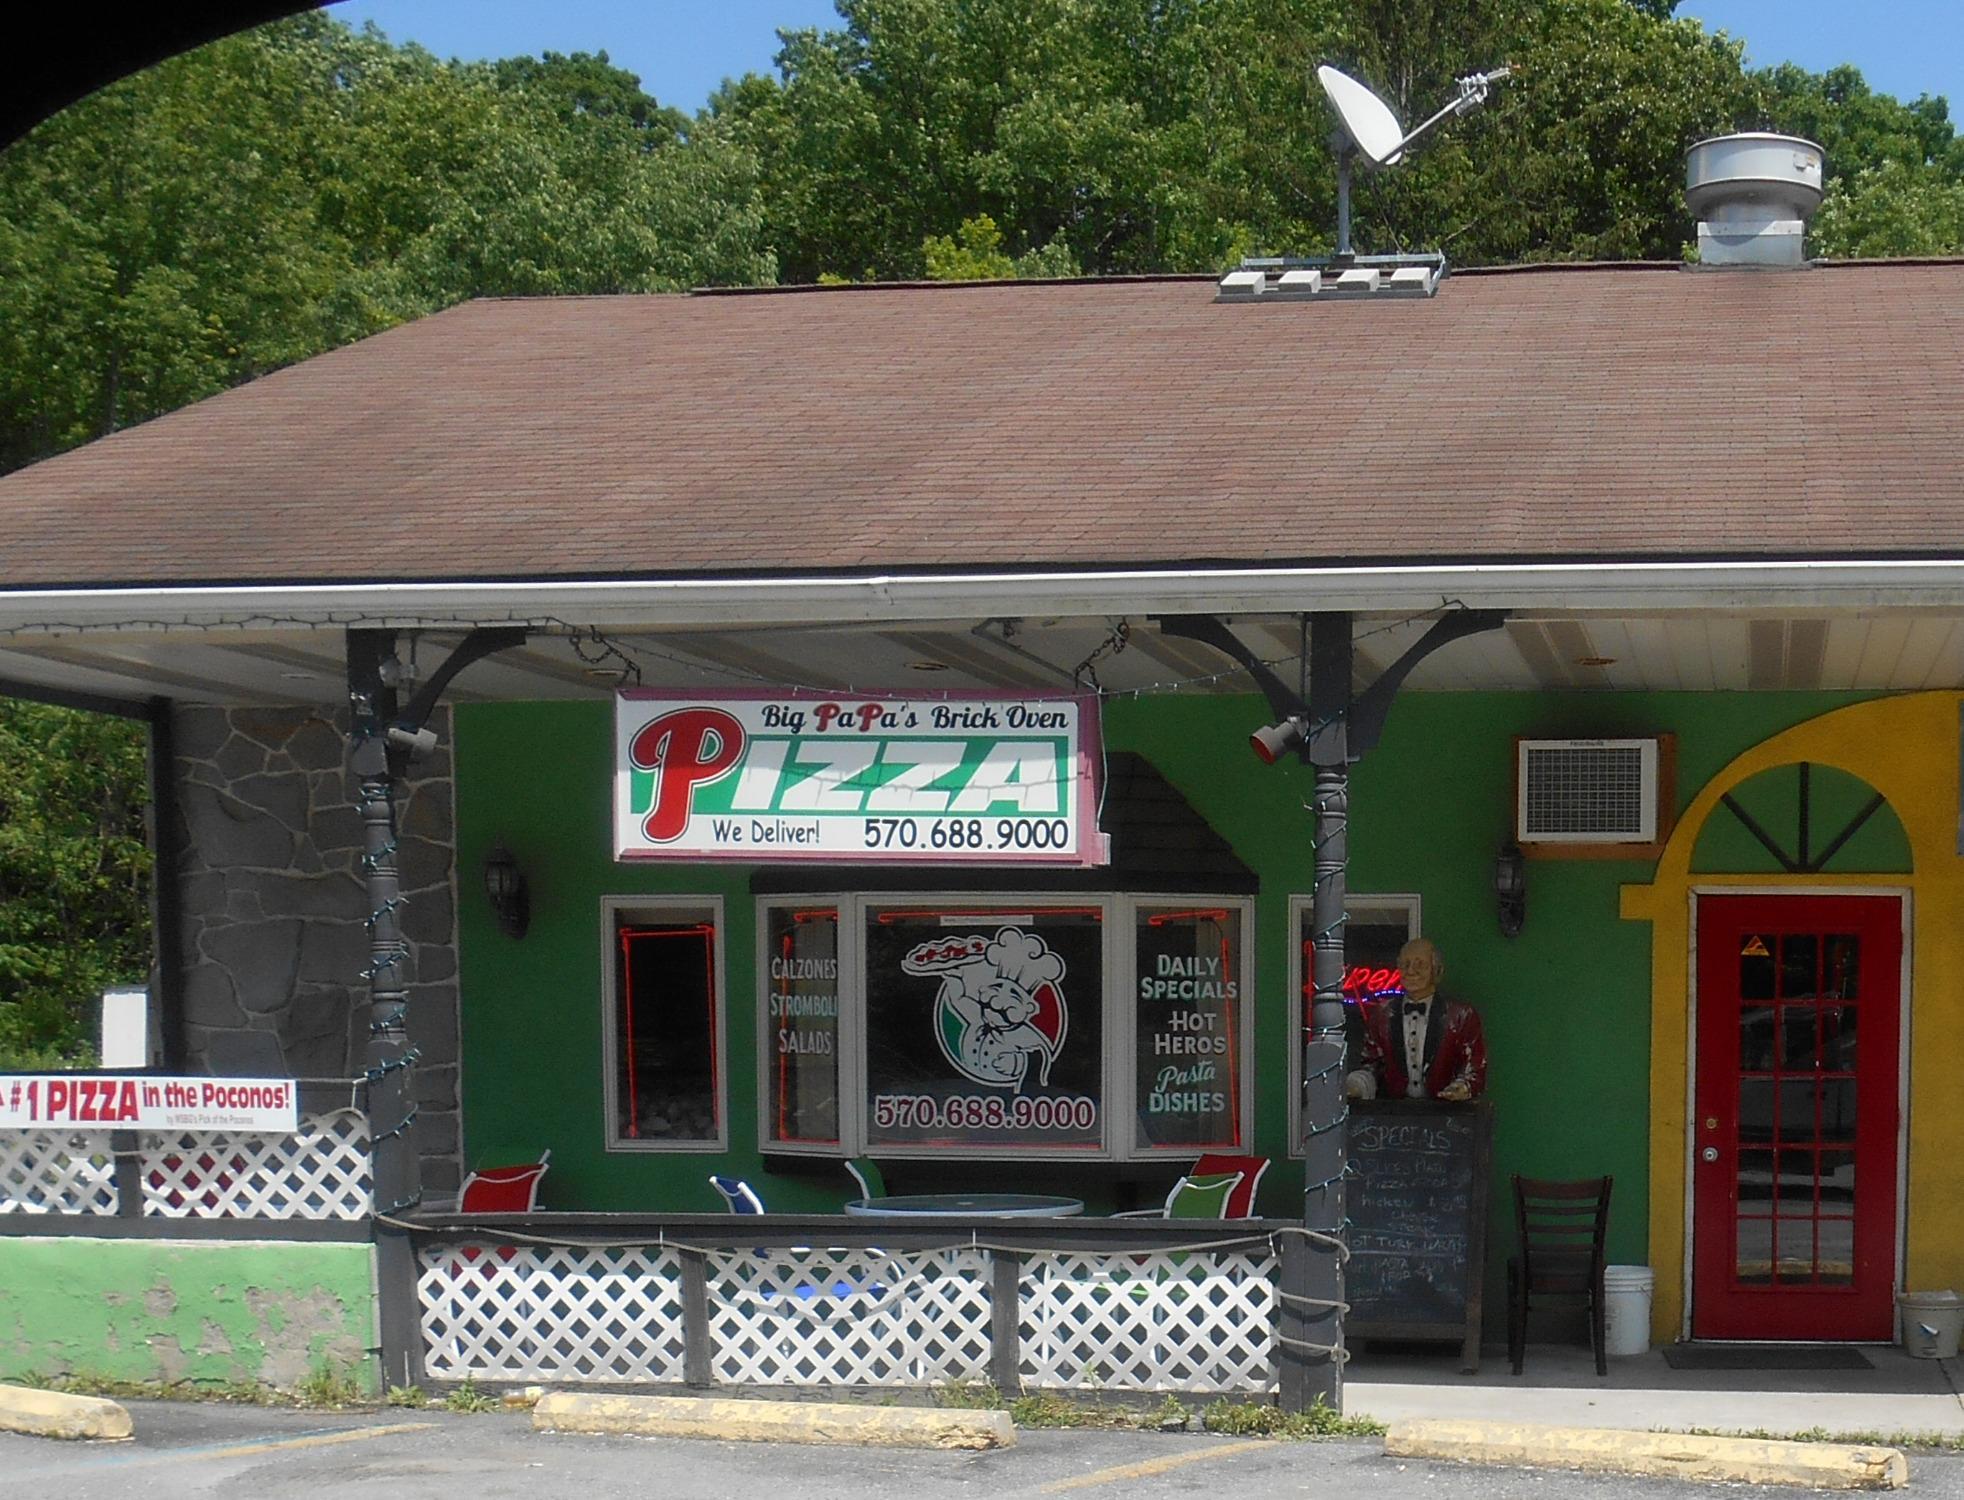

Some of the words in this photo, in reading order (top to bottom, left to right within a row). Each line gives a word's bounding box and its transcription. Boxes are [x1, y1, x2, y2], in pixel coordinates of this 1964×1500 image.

[762, 704, 806, 734] Big
[813, 702, 918, 732] PaPa's
[931, 704, 1000, 729] Brick
[1006, 704, 1069, 729] Oven
[629, 707, 1059, 844] PIZZA
[713, 819, 745, 843] We
[751, 818, 820, 844] Deliver!
[864, 818, 1069, 849] 570.688.9000
[771, 957, 837, 981] CALZONES
[1157, 954, 1219, 976] DAILY
[1141, 976, 1238, 1000] SPECIALS
[1343, 966, 1402, 991] pen
[1168, 1011, 1216, 1032] HOT
[779, 1028, 831, 1054] SALADS
[1154, 1033, 1226, 1055] HEROS
[1155, 1060, 1216, 1093] Pasta
[10, 1080, 38, 1121] #1
[47, 1080, 139, 1121] PIZZA
[142, 1081, 160, 1108] in
[165, 1082, 197, 1108] the
[202, 1083, 290, 1109] Poconos!
[874, 1094, 1096, 1129] 570.688.9000
[1150, 1092, 1225, 1113] DISHES
